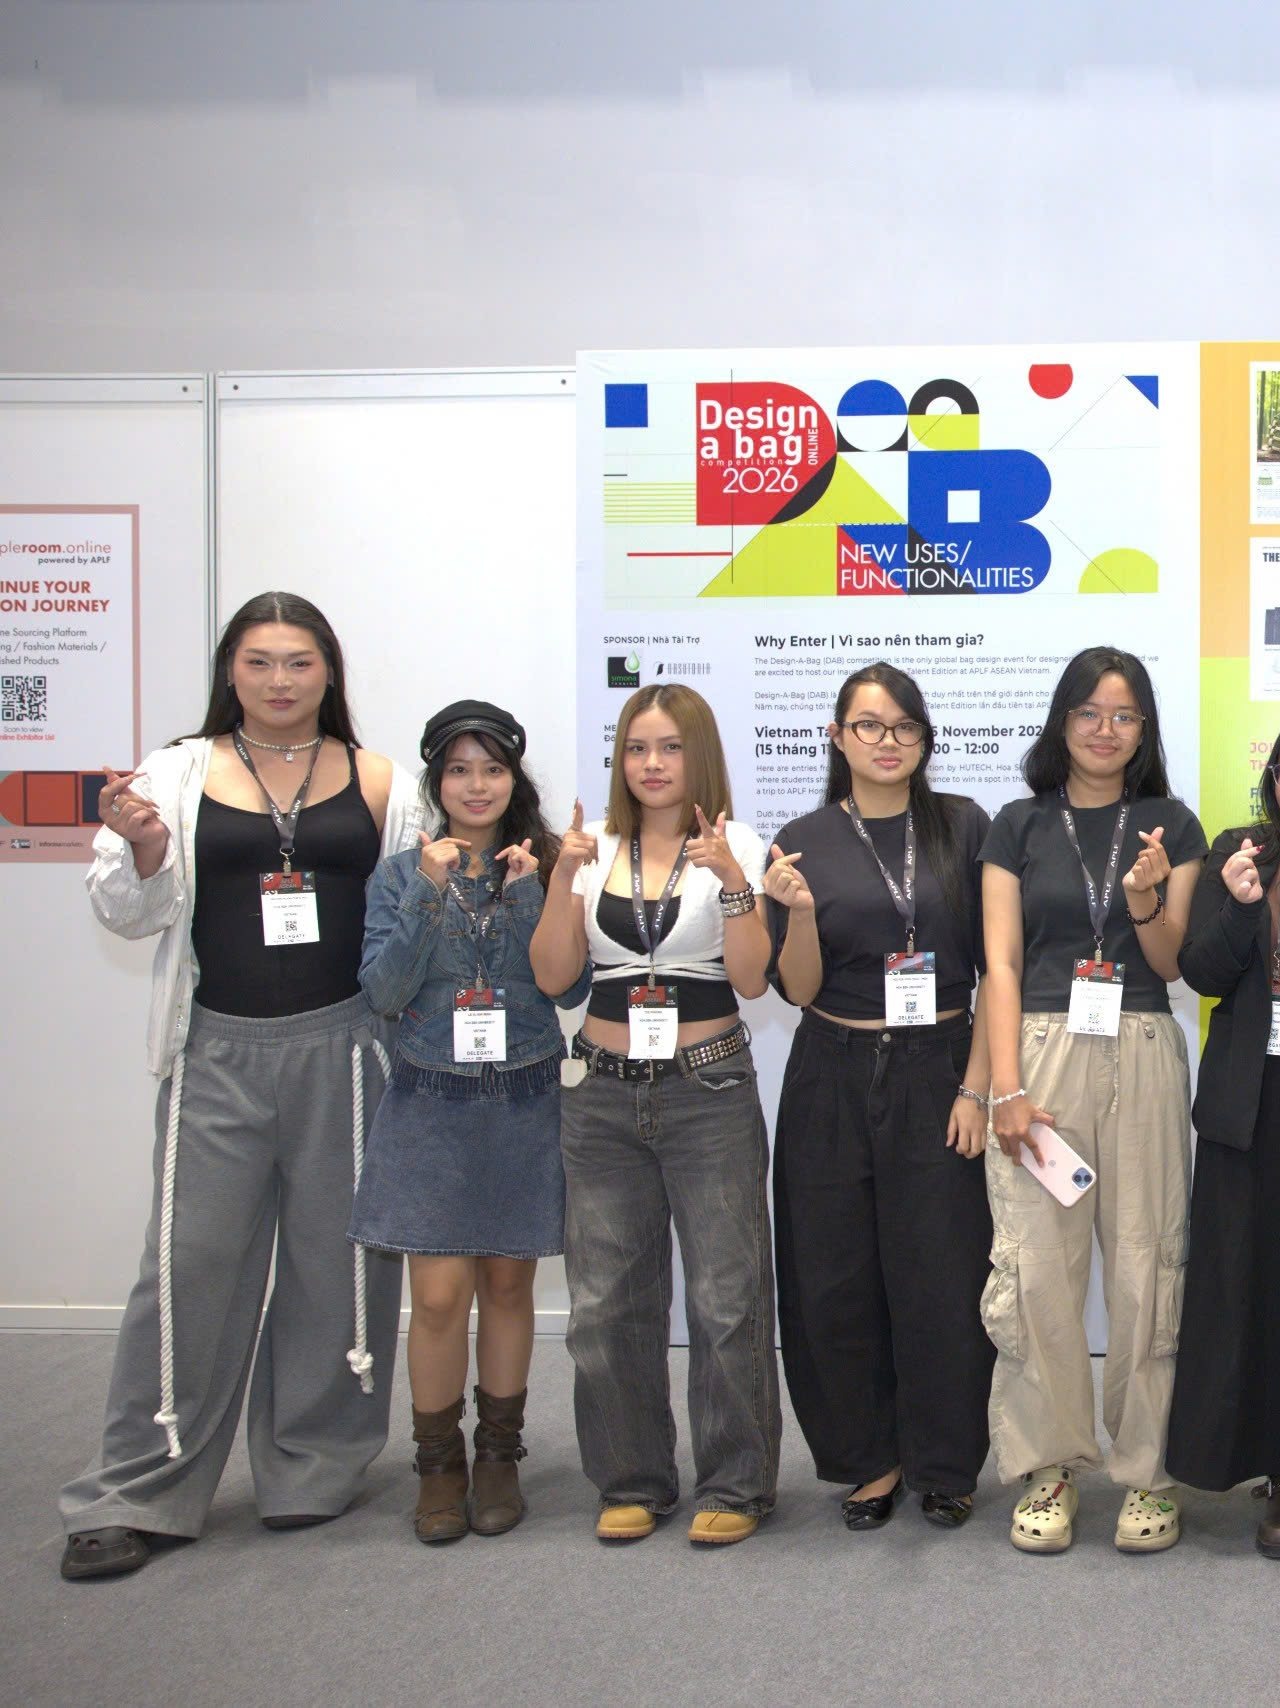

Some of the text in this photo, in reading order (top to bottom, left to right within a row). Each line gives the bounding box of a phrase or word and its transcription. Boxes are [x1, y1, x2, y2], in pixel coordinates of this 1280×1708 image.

[700, 399, 818, 436] Design
[700, 428, 803, 466] a bag
[808, 428, 819, 465] ONLINE
[700, 458, 783, 467] competition
[722, 466, 798, 494] 2026
[841, 540, 972, 566] NEW USES/
[1263, 552, 1280, 563] THE
[38, 555, 111, 566] powered by APLF
[840, 567, 1034, 590] FUNCTIONALITIES
[44, 580, 91, 593] YOUR
[32, 599, 110, 613] JOURNEY
[12, 628, 50, 639] Sourcing
[52, 628, 88, 637] Platform
[603, 636, 646, 644] SPONSOR
[653, 636, 670, 644] Nhà
[672, 636, 684, 644] Tài
[754, 634, 984, 649] Why Enter Vì sao nên tham gia?
[23, 641, 55, 651] Fashion
[58, 642, 98, 651] Materials
[24, 656, 60, 665] Products
[754, 657, 768, 665] The
[770, 657, 821, 665] Design-A-Bag
[823, 657, 845, 665] (DAB)
[934, 656, 958, 665] global
[959, 656, 974, 665] bag
[976, 655, 1002, 665] design
[1027, 655, 1037, 663] for
[767, 668, 793, 676] excited
[805, 668, 821, 676] host
[932, 667, 958, 675] Edition
[969, 667, 989, 675] APLF
[990, 667, 1016, 675] ASEAN
[754, 691, 805, 700] Design-A-Bag
[807, 691, 829, 700] (DAB)
[950, 701, 977, 709] Edition
[754, 725, 813, 738] Vietnam
[942, 725, 1015, 737] November
[755, 743, 773, 758] (15
[776, 743, 817, 758] tháng
[964, 743, 999, 755] 12:00
[947, 764, 956, 773] by
[984, 776, 1001, 784] spot
